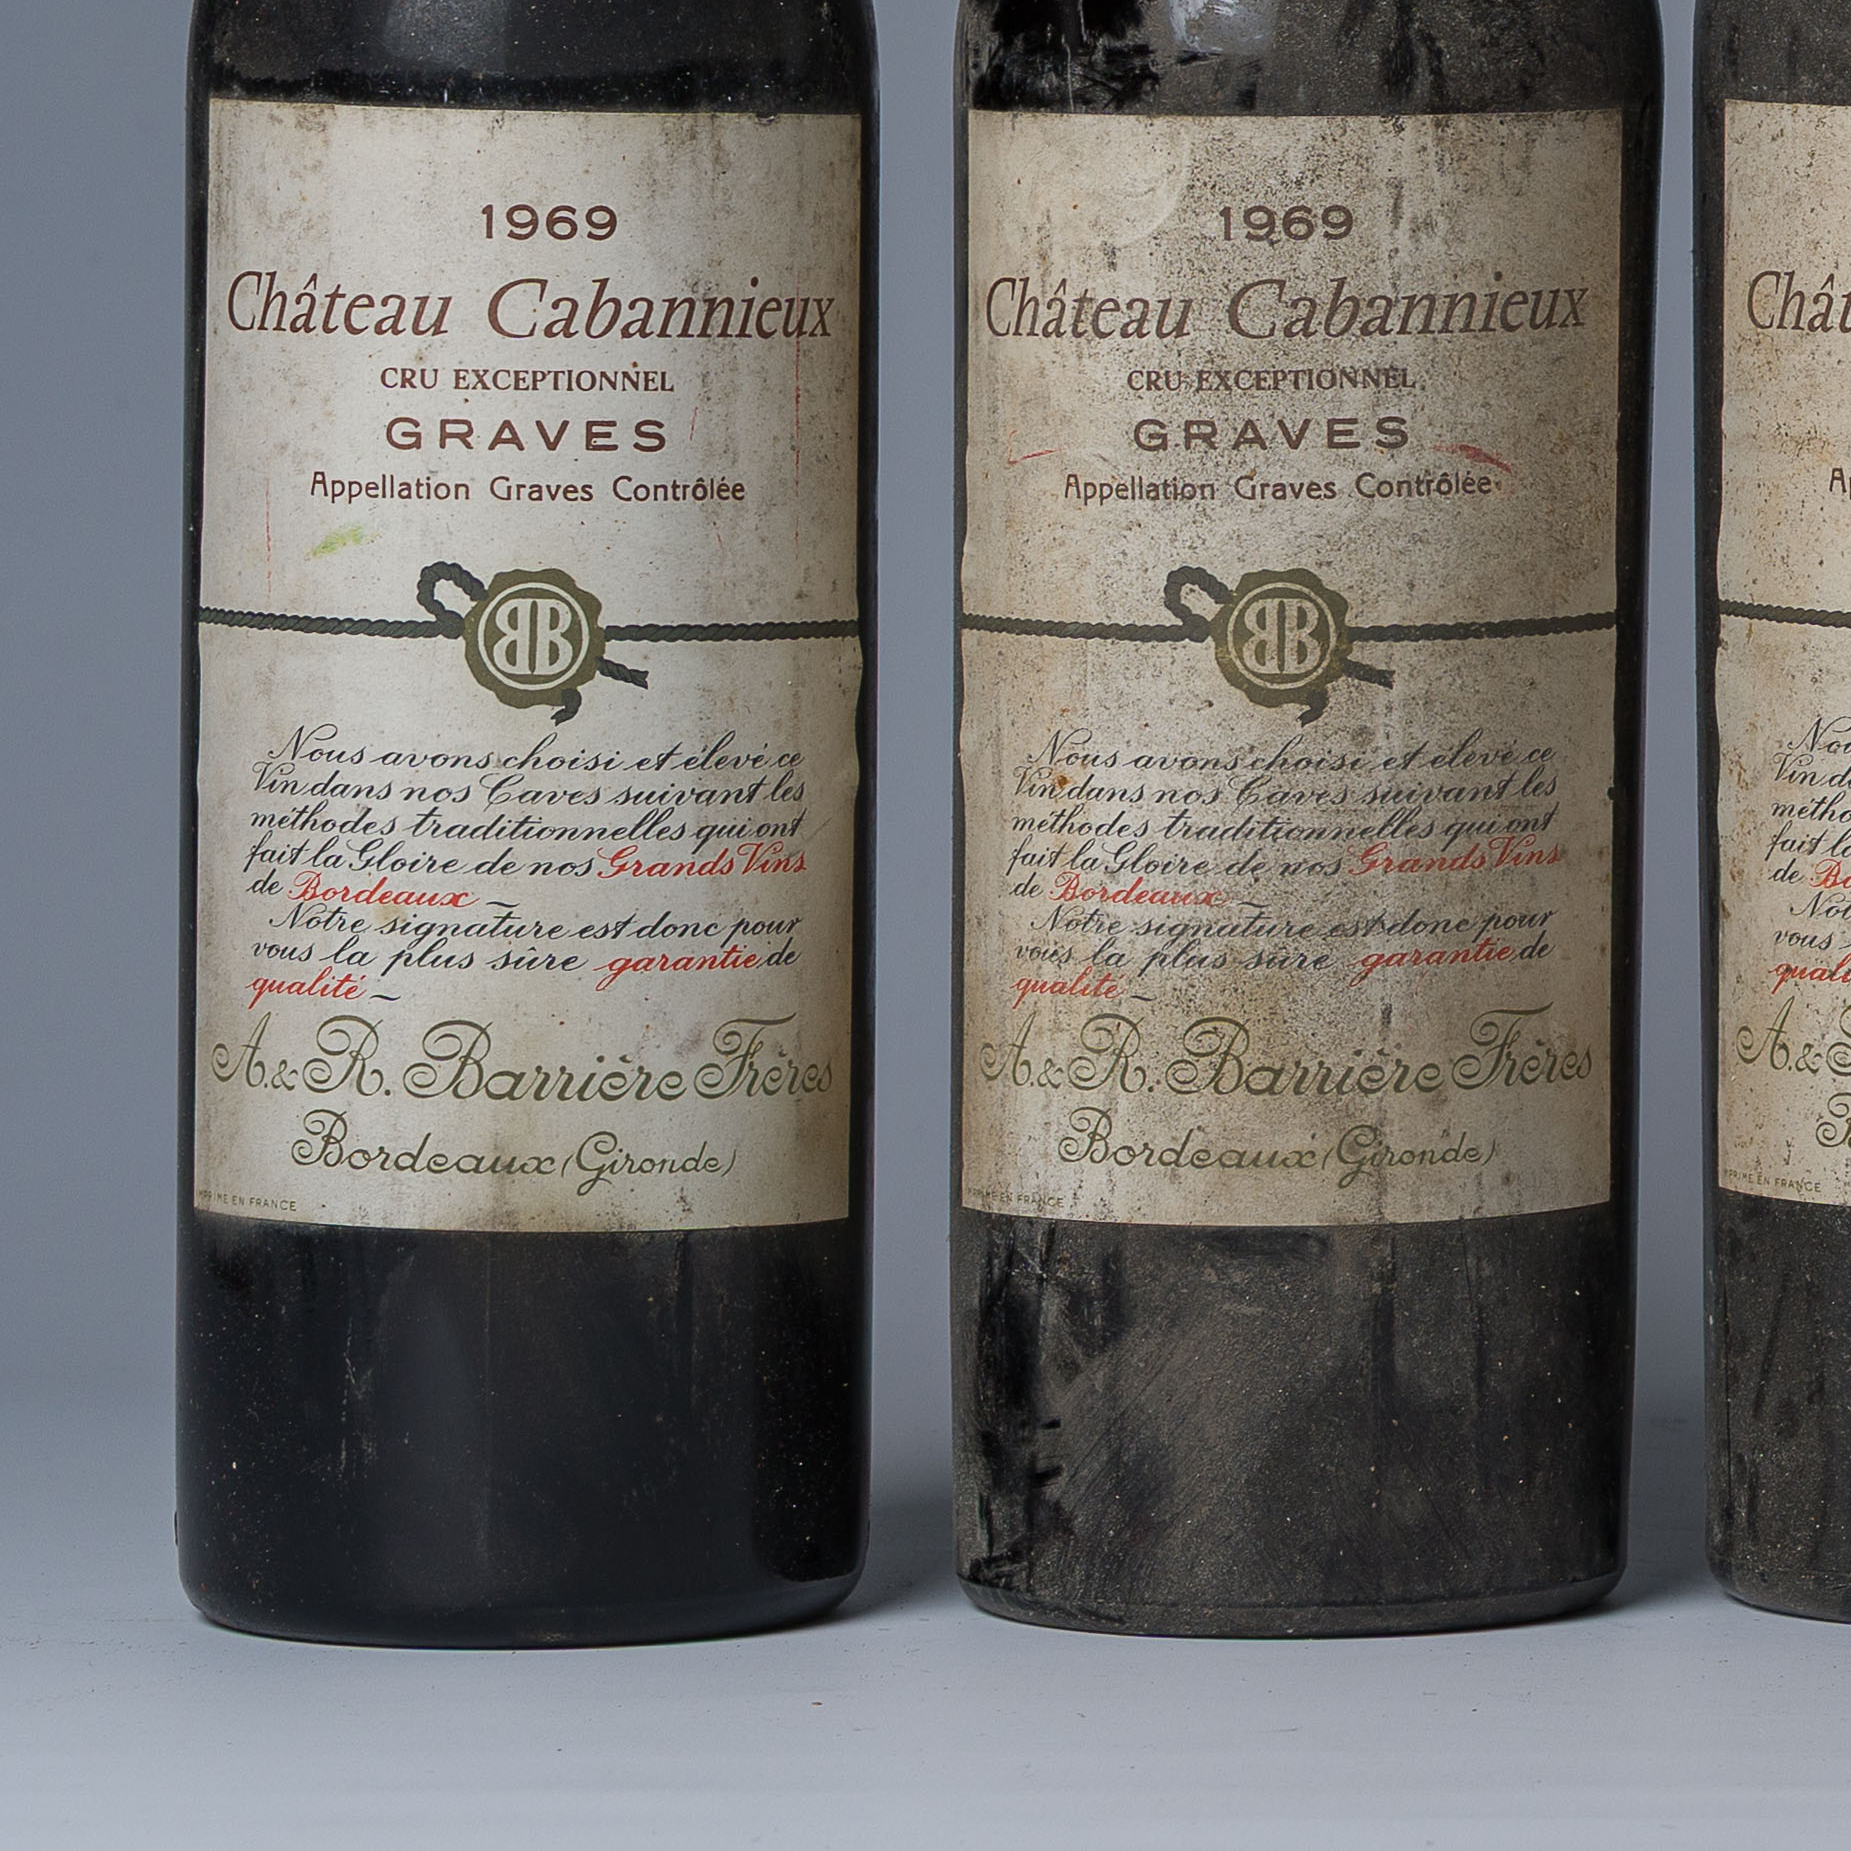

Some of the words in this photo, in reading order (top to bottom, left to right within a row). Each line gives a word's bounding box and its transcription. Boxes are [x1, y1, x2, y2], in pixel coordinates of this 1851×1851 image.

[481, 204, 617, 241] 1969
[1218, 205, 1354, 242] 1969
[226, 270, 451, 337] Château
[488, 275, 832, 344] Cabannieux
[984, 276, 1193, 340] Château
[1227, 271, 1588, 341] Cabannieux
[381, 367, 438, 389] CRU
[454, 369, 672, 392] EXCEPTIONNEL
[1127, 370, 1182, 392] CRU
[1195, 368, 1413, 391] EXCEPTIONNEL
[385, 417, 665, 453] GRAVES
[1131, 416, 1406, 452] GRAVES
[311, 471, 469, 503] Appellation
[490, 476, 592, 501] Graves
[612, 476, 746, 504] Contrôlée
[1063, 475, 1214, 505] Appellation
[1235, 475, 1335, 500] Graves
[1356, 471, 1490, 499] Contrôlée
[289, 1110, 554, 1174] Bordeaux
[1055, 1105, 1314, 1169] Bordeaux
